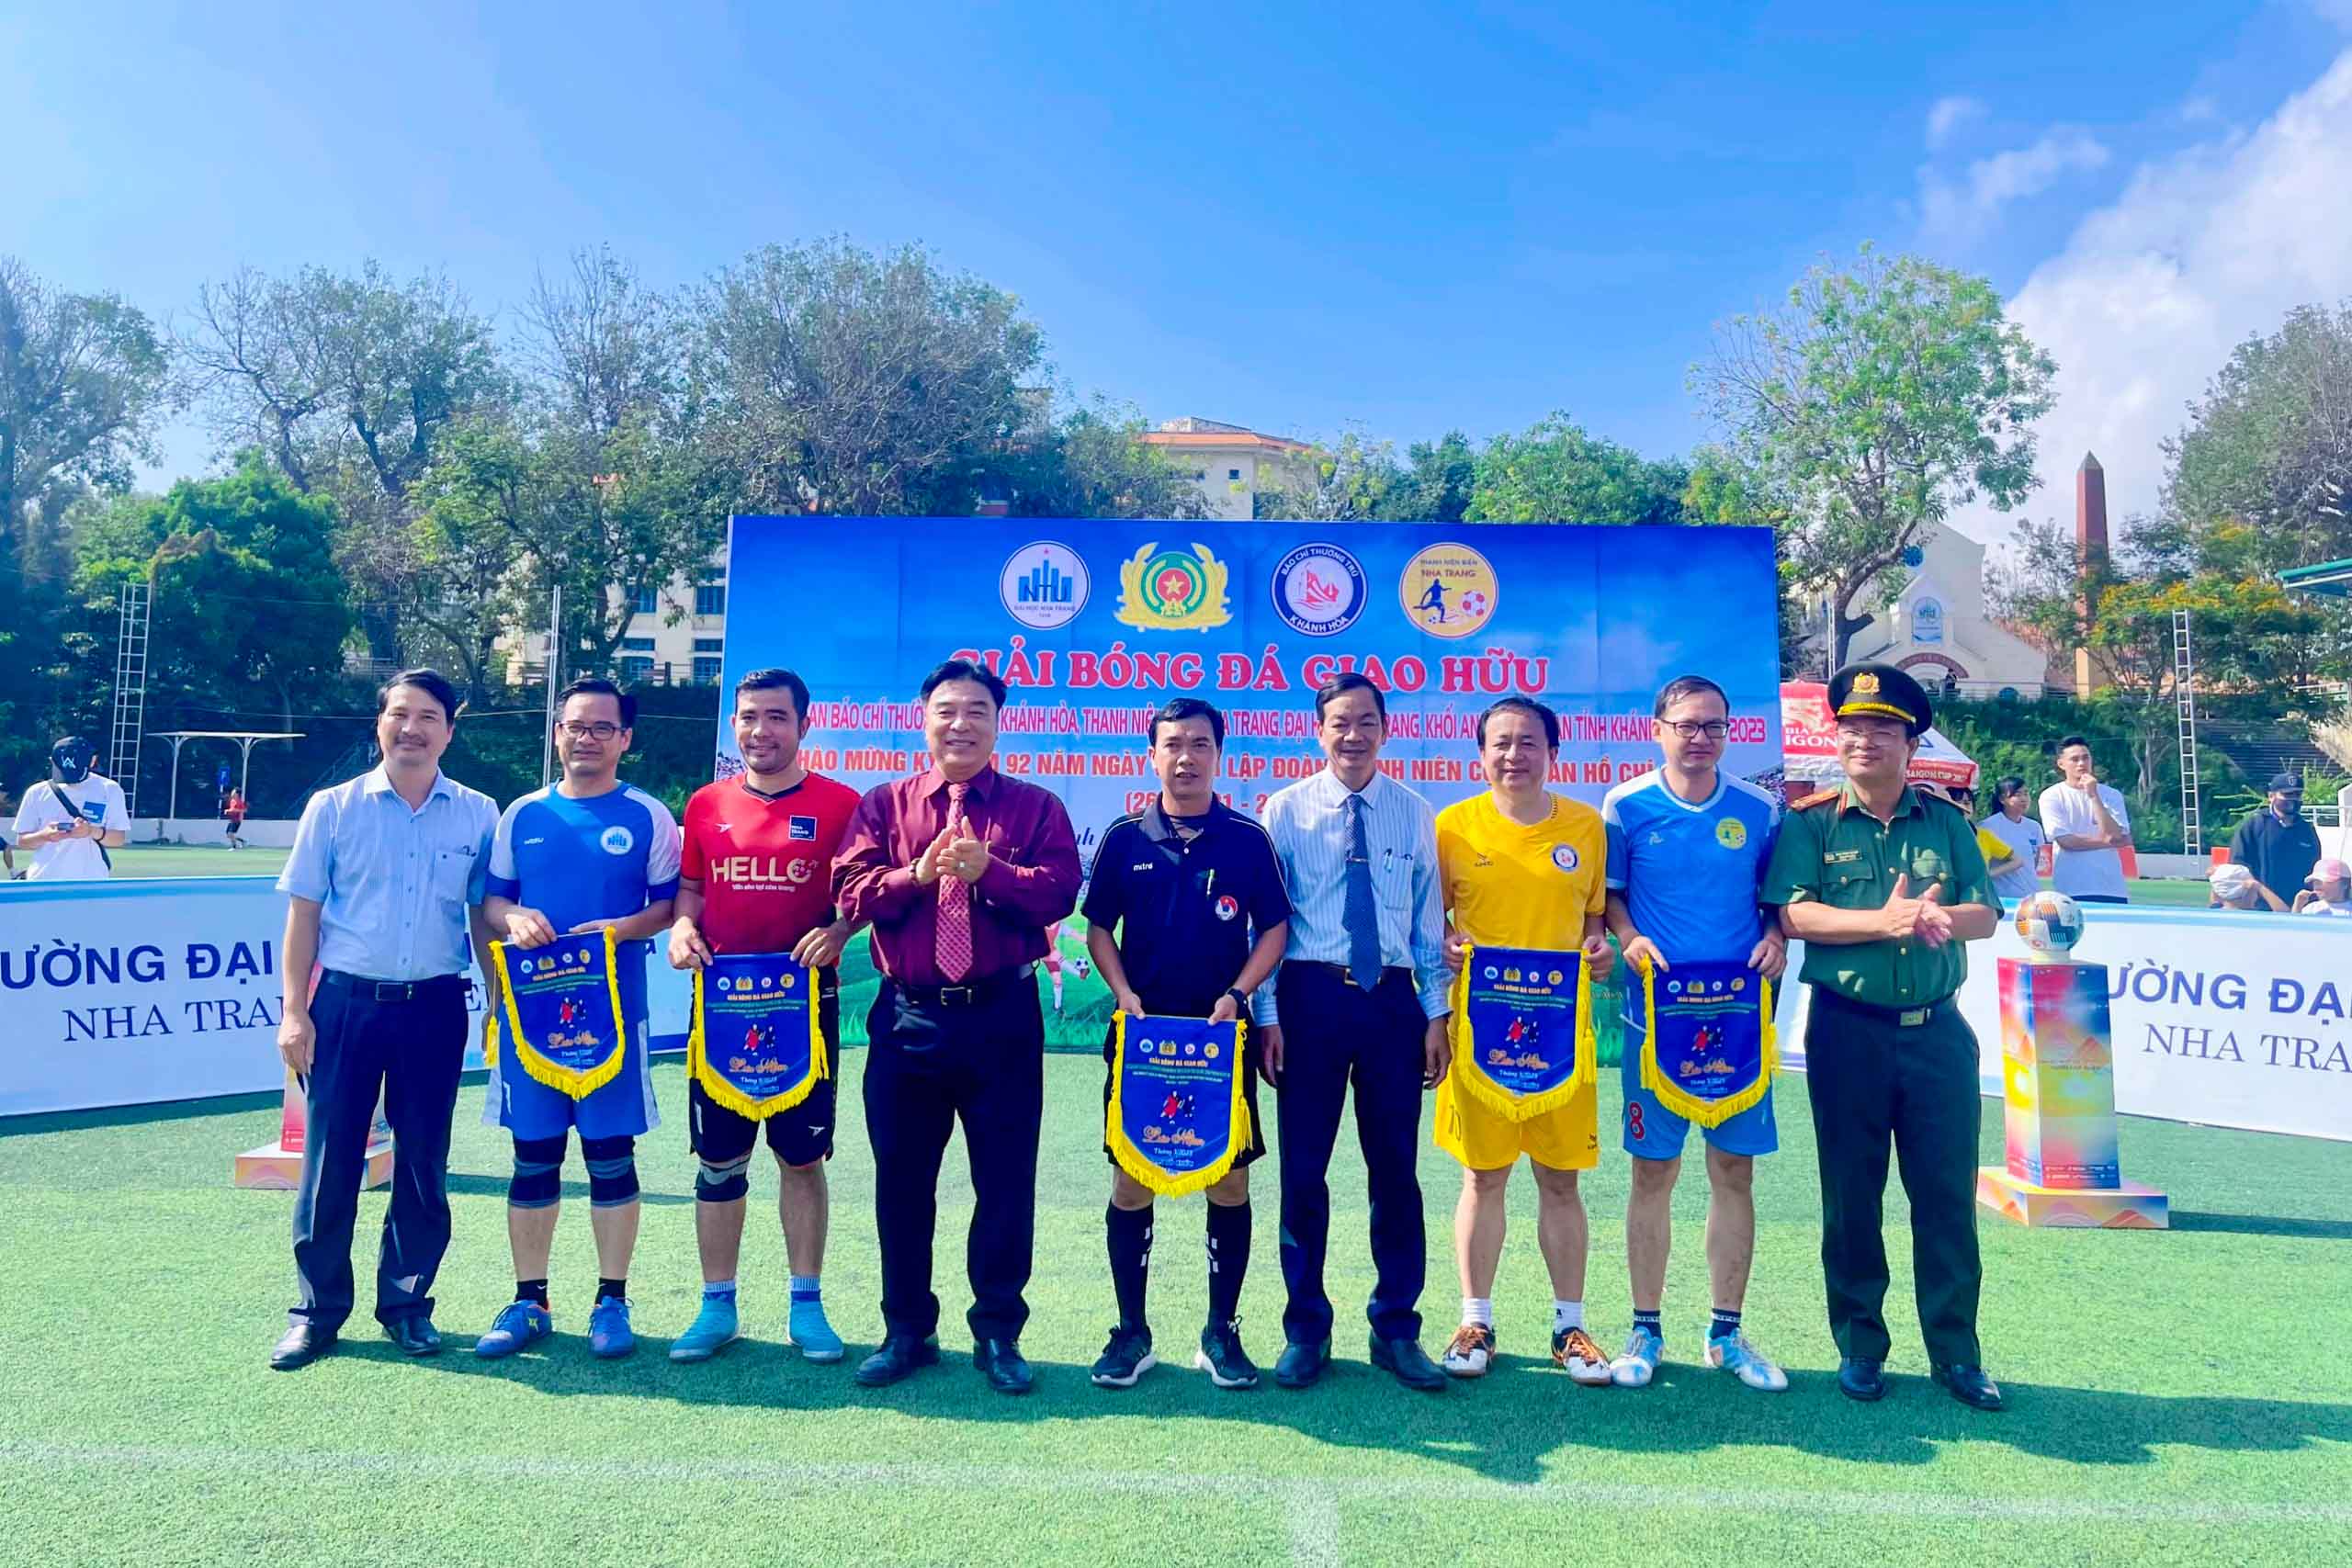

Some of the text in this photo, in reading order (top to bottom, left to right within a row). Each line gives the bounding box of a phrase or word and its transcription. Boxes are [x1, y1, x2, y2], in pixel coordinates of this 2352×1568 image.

[949, 635, 1056, 687] IẢI
[1068, 641, 1204, 689] BÓNG
[1216, 643, 1290, 691] ĐÁ
[1441, 647, 1549, 694] HỮU
[831, 698, 859, 728] BÁO
[863, 698, 883, 729] CHÍ
[888, 699, 925, 730] THƯỜ
[1000, 700, 1046, 732] KHÁNH
[1083, 707, 1128, 734] THANH
[1131, 702, 1155, 734] NIÊ
[1284, 712, 1307, 742] ĐẠI
[1426, 703, 1457, 739] KHỐI
[1785, 727, 1809, 736] BIA
[1785, 735, 1838, 749] IGON
[797, 745, 837, 771] HÀO
[844, 747, 906, 773] MỪNG
[1006, 753, 1031, 774] 92
[1037, 750, 1085, 775] NĂM
[1091, 750, 1148, 776] NGÀY
[1227, 752, 1266, 783] LẬP
[1411, 755, 1462, 782] NIÊN
[1584, 754, 1611, 784] HỒ
[0, 939, 273, 989] ƯỜNG ĐẠI
[2108, 958, 2352, 1026] ƯỜNG ĐẠ
[62, 996, 283, 1042] NHA TRA
[2142, 1022, 2352, 1074] NHA TRA
[1629, 1101, 1645, 1139] 8
